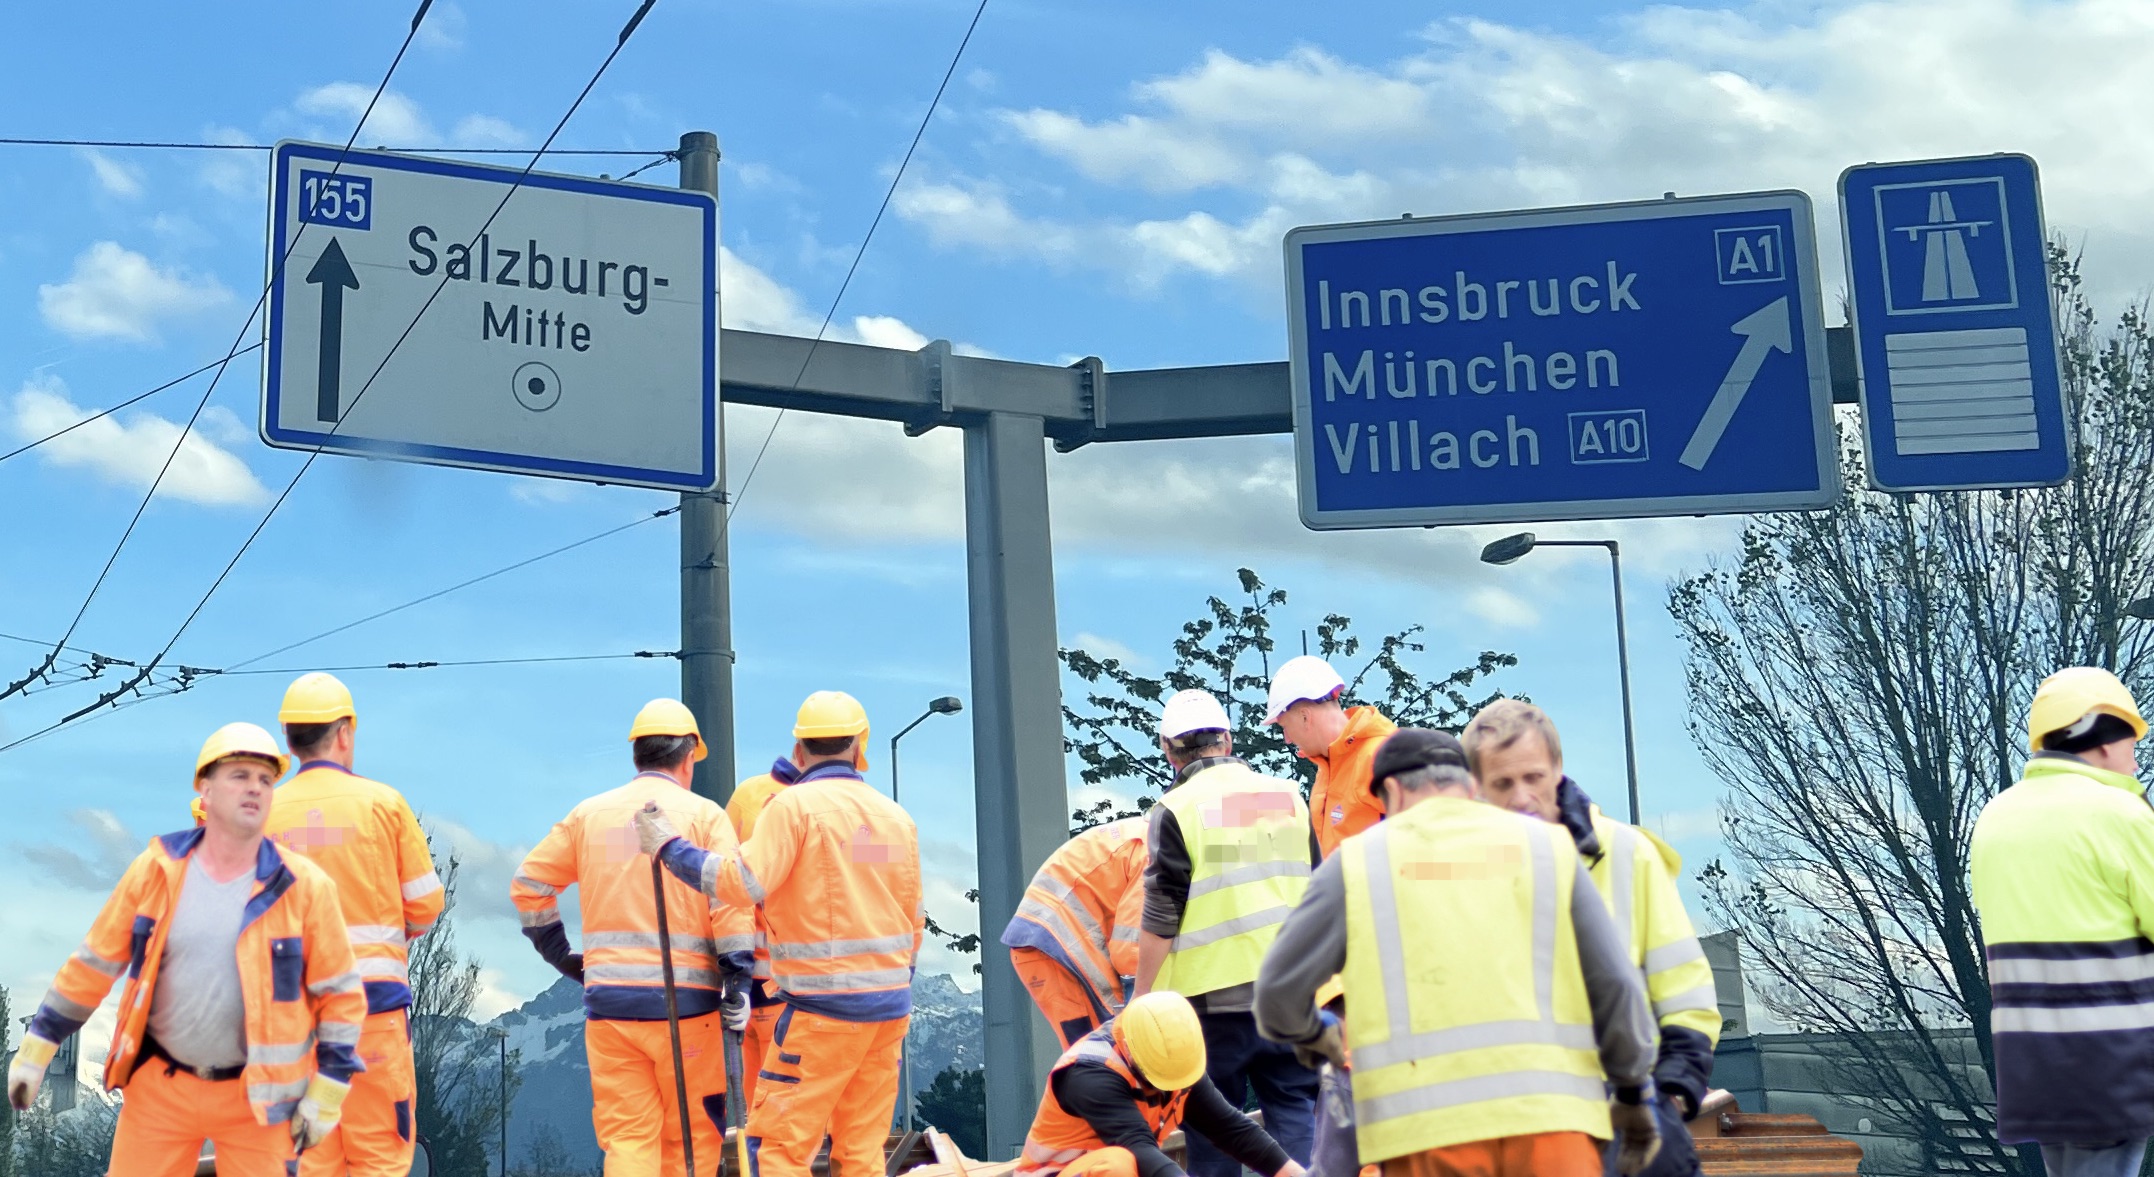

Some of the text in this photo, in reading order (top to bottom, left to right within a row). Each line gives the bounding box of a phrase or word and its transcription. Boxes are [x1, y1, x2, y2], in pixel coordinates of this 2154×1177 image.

[305, 177, 367, 222] 155
[408, 225, 669, 315] Salzburg-
[1728, 234, 1776, 275] A1
[1319, 260, 1641, 330] Innsbruck
[482, 301, 591, 352] Mitte
[1323, 341, 1620, 402] München
[1325, 415, 1641, 474] Villach A10
